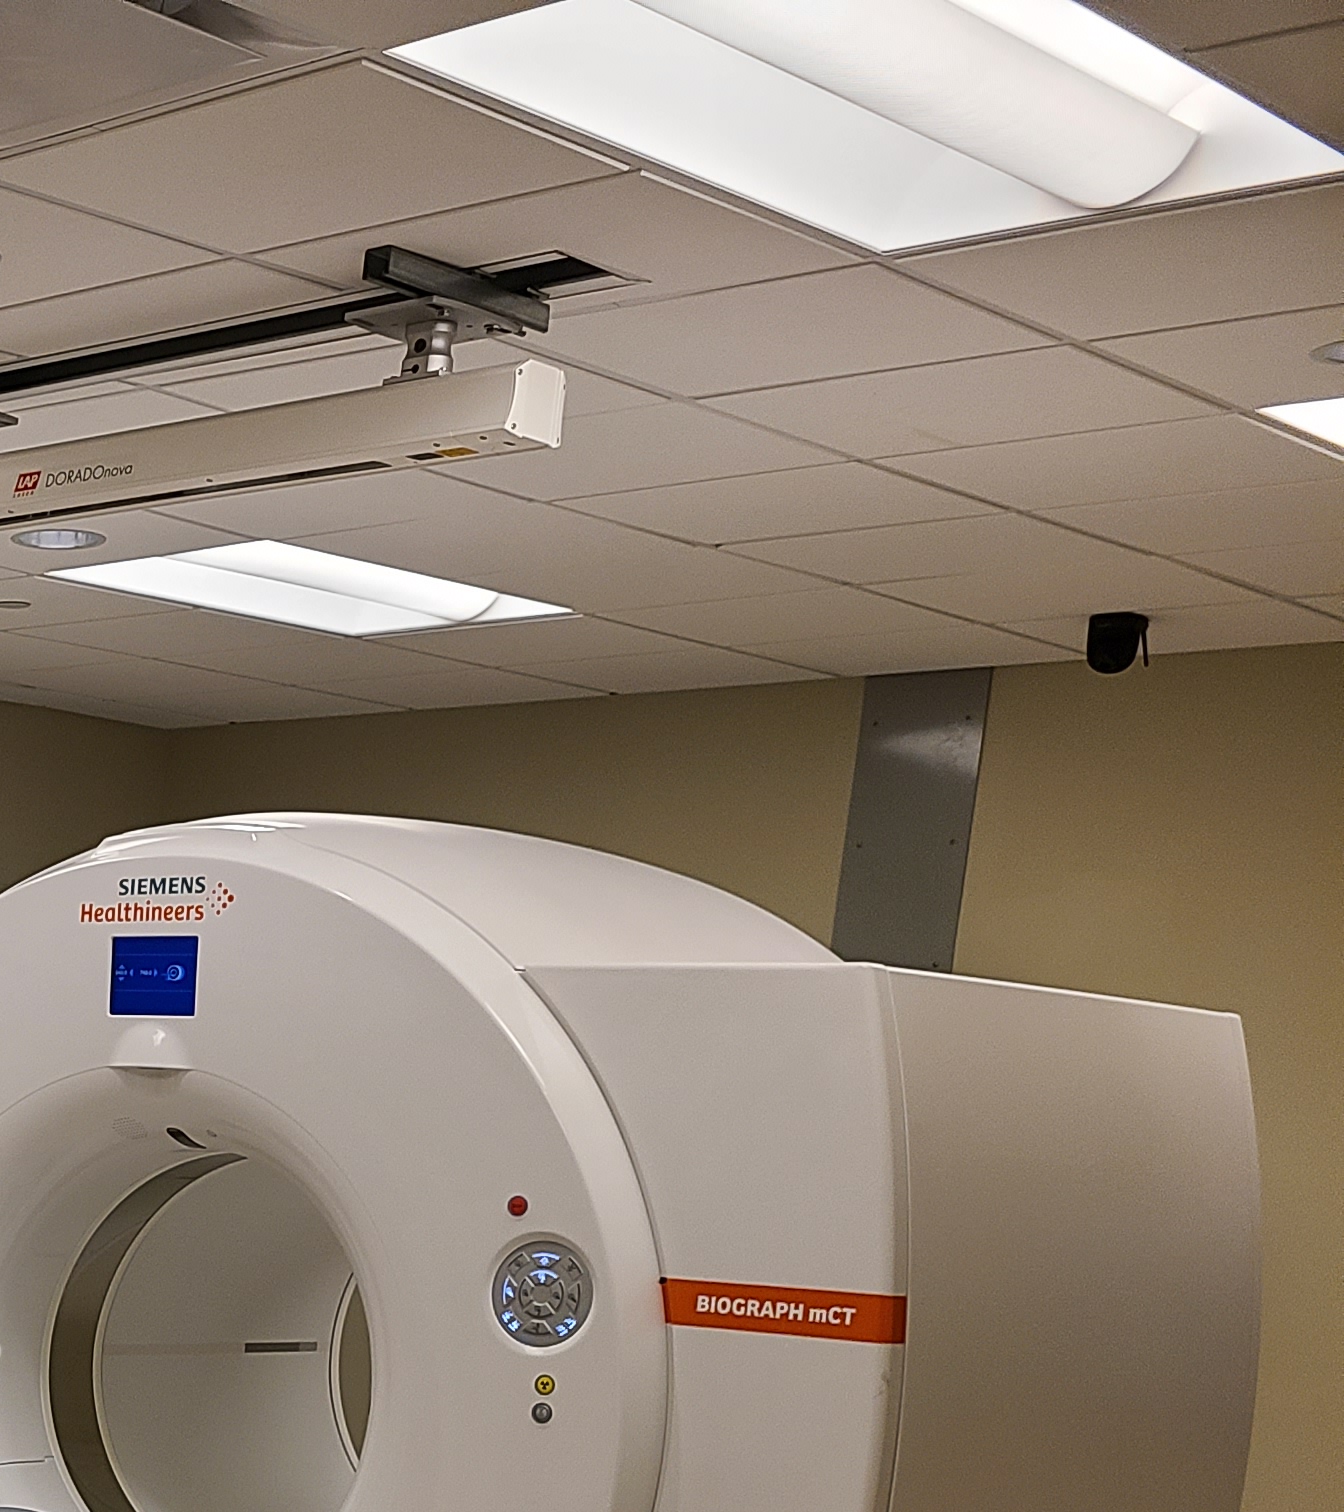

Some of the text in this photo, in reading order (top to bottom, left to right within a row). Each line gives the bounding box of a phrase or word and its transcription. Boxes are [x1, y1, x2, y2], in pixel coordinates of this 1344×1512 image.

[17, 465, 133, 489] LAP DORADOnova
[118, 876, 206, 896] SIEMENS
[80, 900, 205, 923] Healthineers
[695, 1294, 857, 1326] BIOGRAPH mCT
